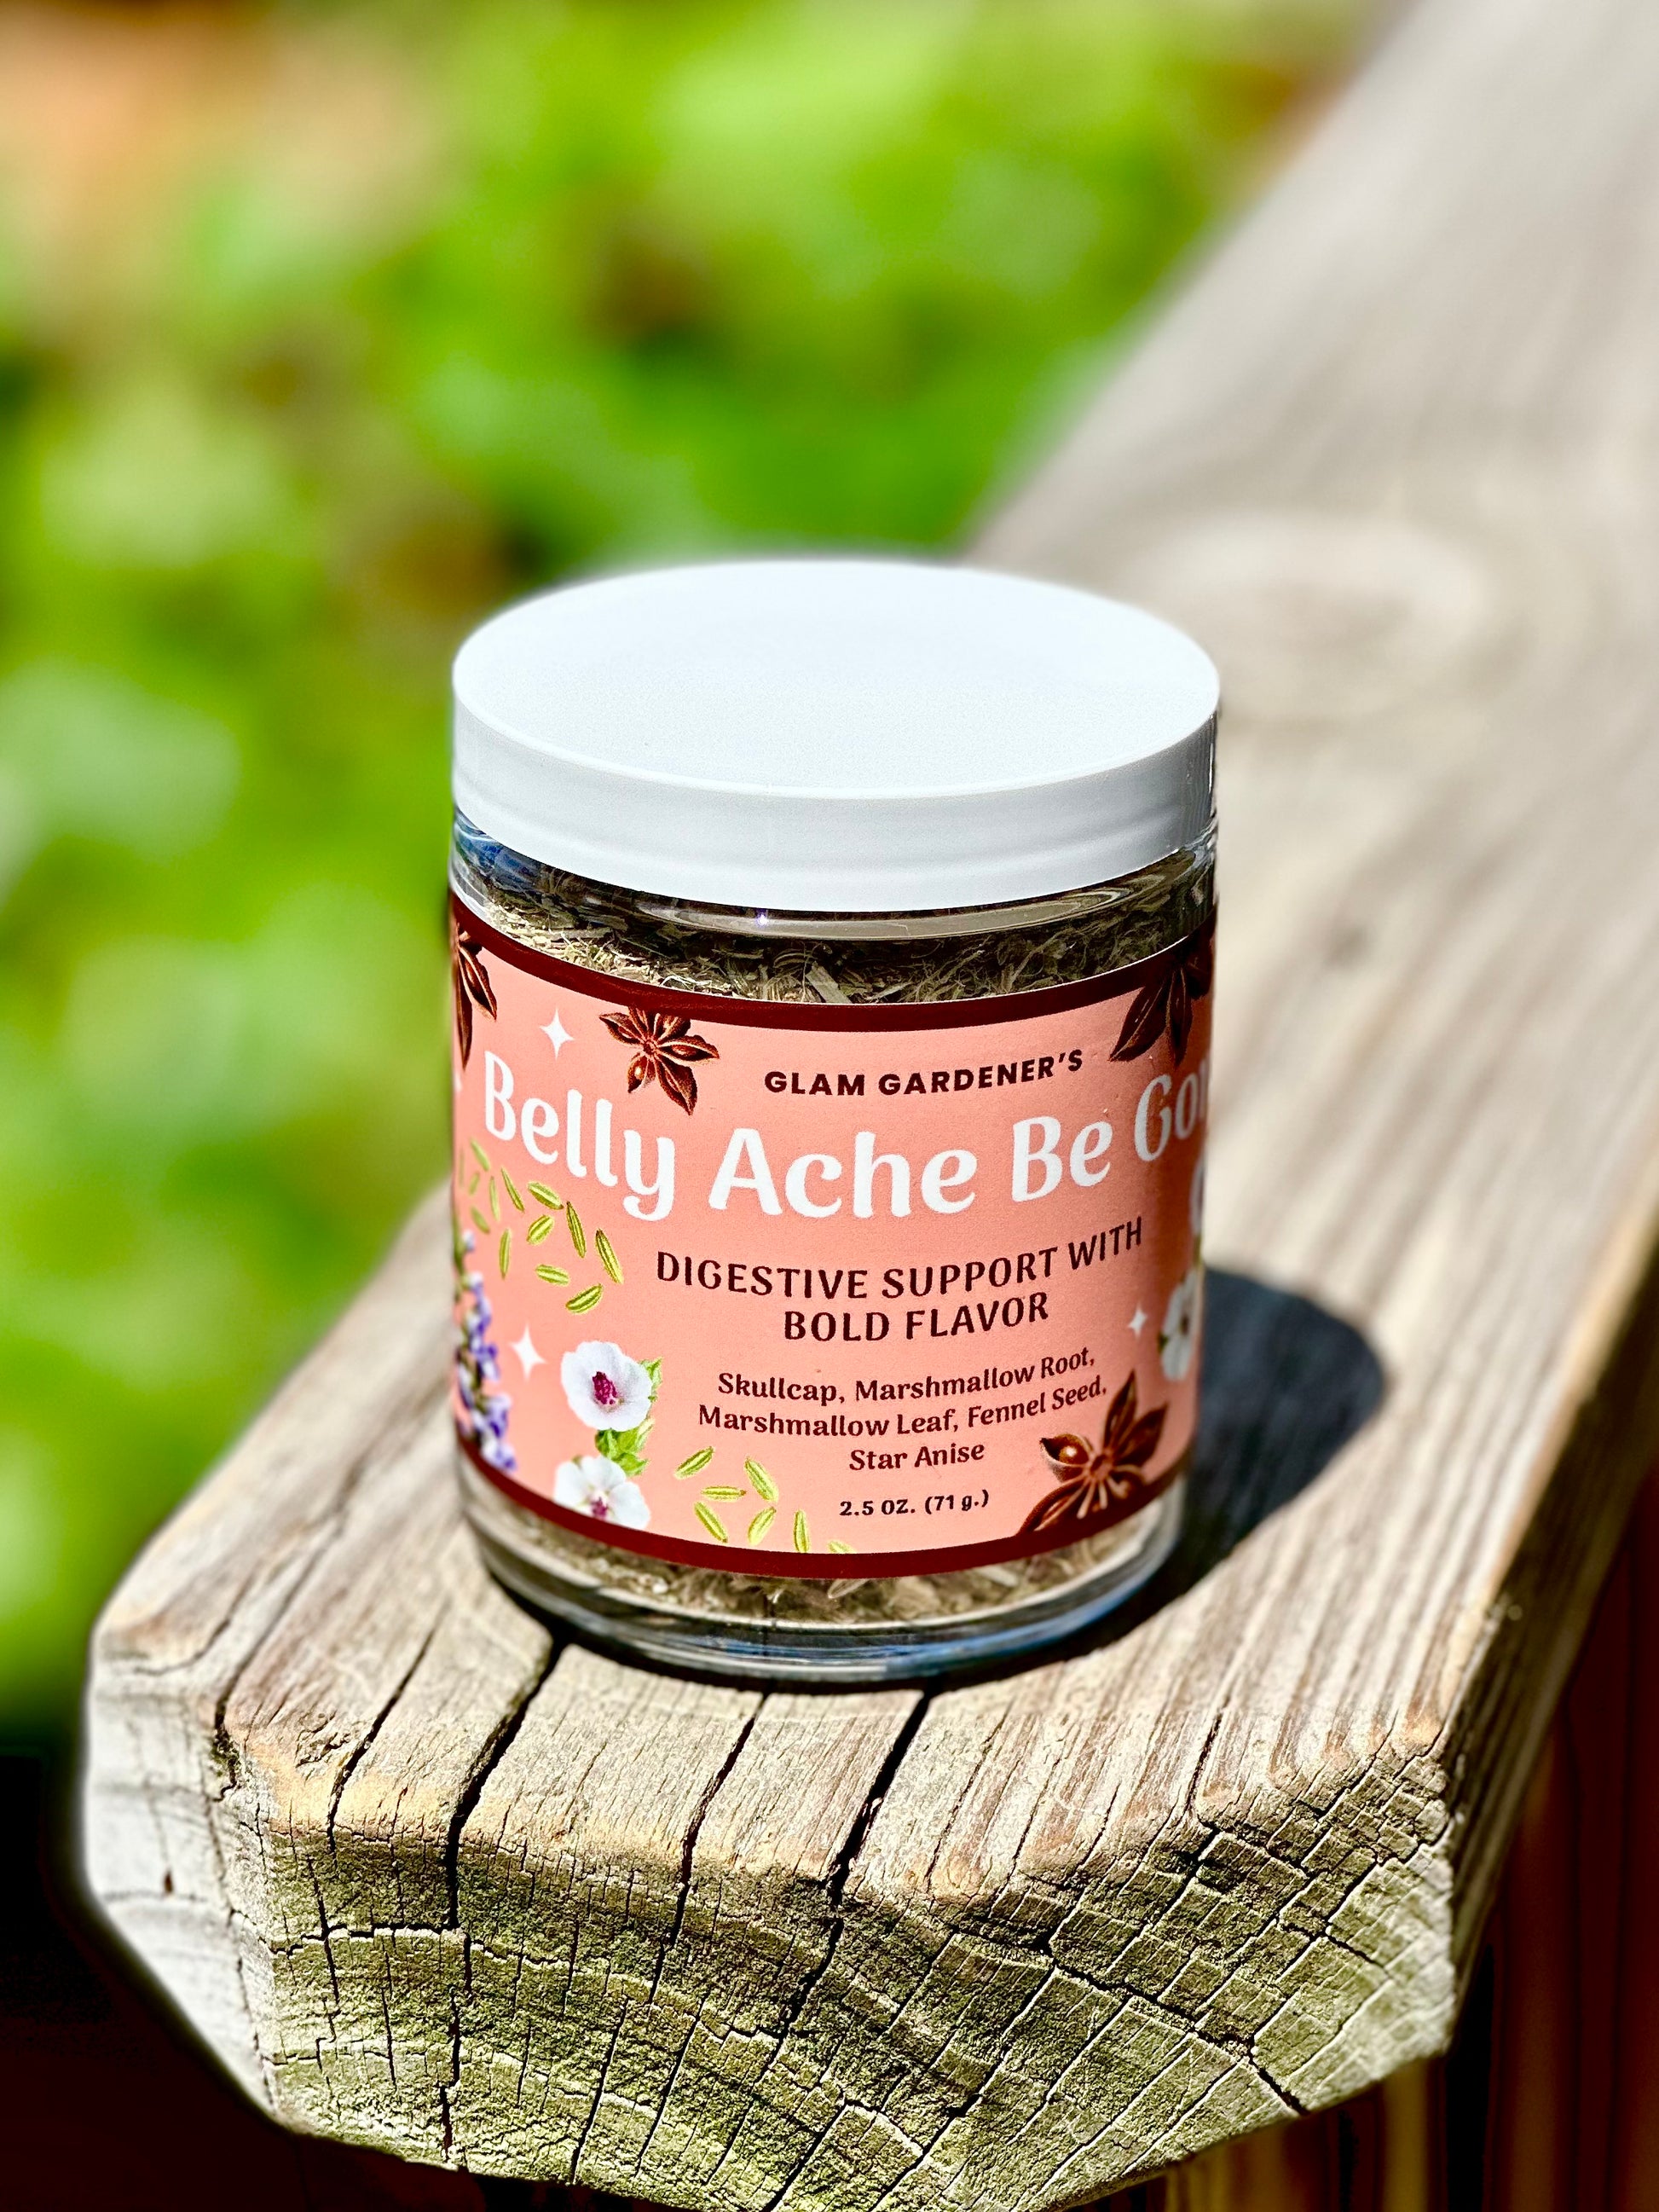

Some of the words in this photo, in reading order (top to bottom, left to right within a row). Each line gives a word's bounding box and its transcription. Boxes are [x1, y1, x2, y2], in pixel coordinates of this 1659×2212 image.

[765, 1072, 864, 1096] GLAM
[879, 1050, 1082, 1095] GARDENER'S
[485, 1051, 675, 1221] Belly
[708, 1128, 977, 1219] Ache
[1012, 1116, 1112, 1202] Be
[657, 1252, 867, 1300] DIGESTIVE
[882, 1247, 1058, 1298] SUPPORT
[1067, 1217, 1142, 1271] WITH
[785, 1312, 889, 1341] BOLD
[906, 1292, 1048, 1340] FLAVOR
[719, 1373, 844, 1406] Skullcap,
[856, 1366, 1035, 1401] Marshmallow
[1041, 1347, 1094, 1379] Root,
[700, 1404, 889, 1436] Marshmallow
[898, 1409, 957, 1434] Leaf,
[968, 1392, 1045, 1427] Fennel
[850, 1451, 907, 1470] Star
[915, 1443, 984, 1467] Anise
[840, 1501, 874, 1515] 2.5
[925, 1495, 954, 1514] (71
